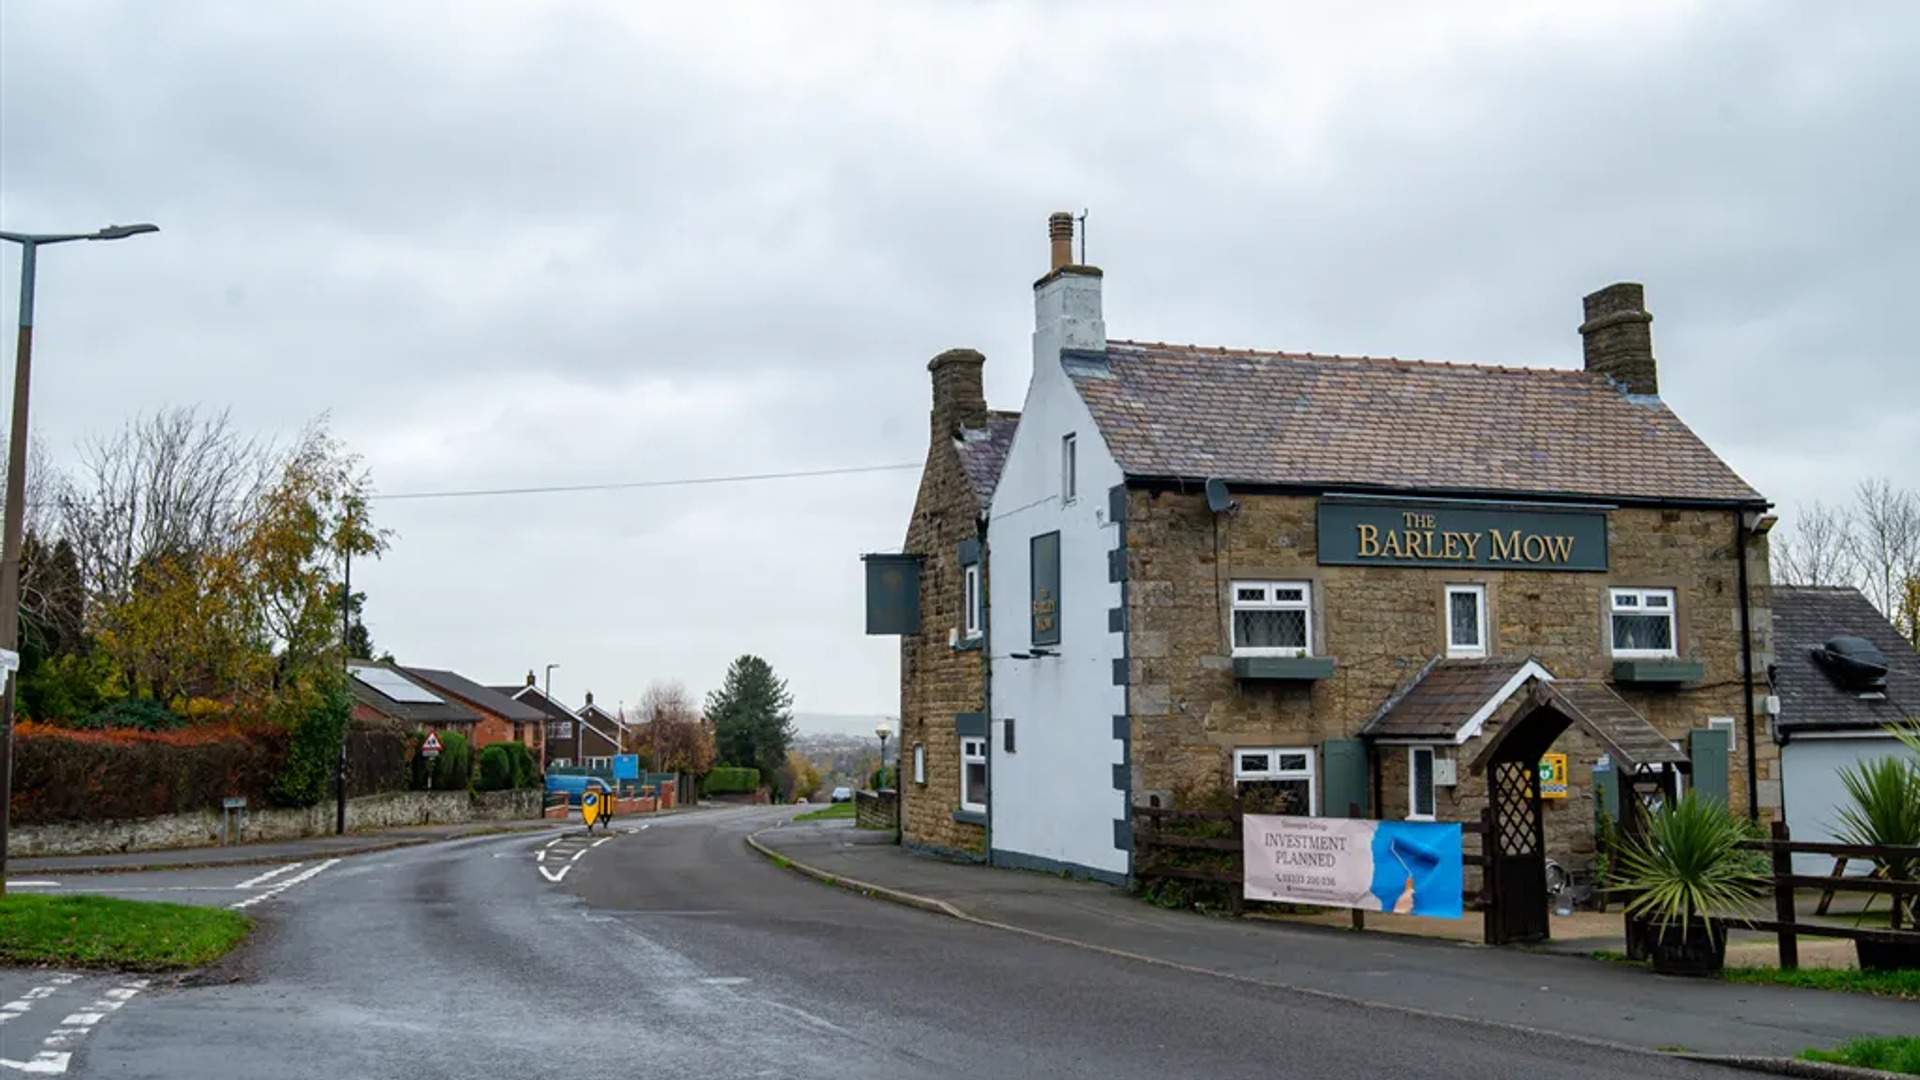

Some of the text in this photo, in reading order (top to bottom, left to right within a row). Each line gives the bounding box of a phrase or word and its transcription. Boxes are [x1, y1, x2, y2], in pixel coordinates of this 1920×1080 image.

[1402, 511, 1436, 529] THE
[1357, 524, 1575, 563] BARLEY MOW
[1265, 832, 1347, 851] INVESTMENT
[1275, 850, 1336, 868] PLANNED
